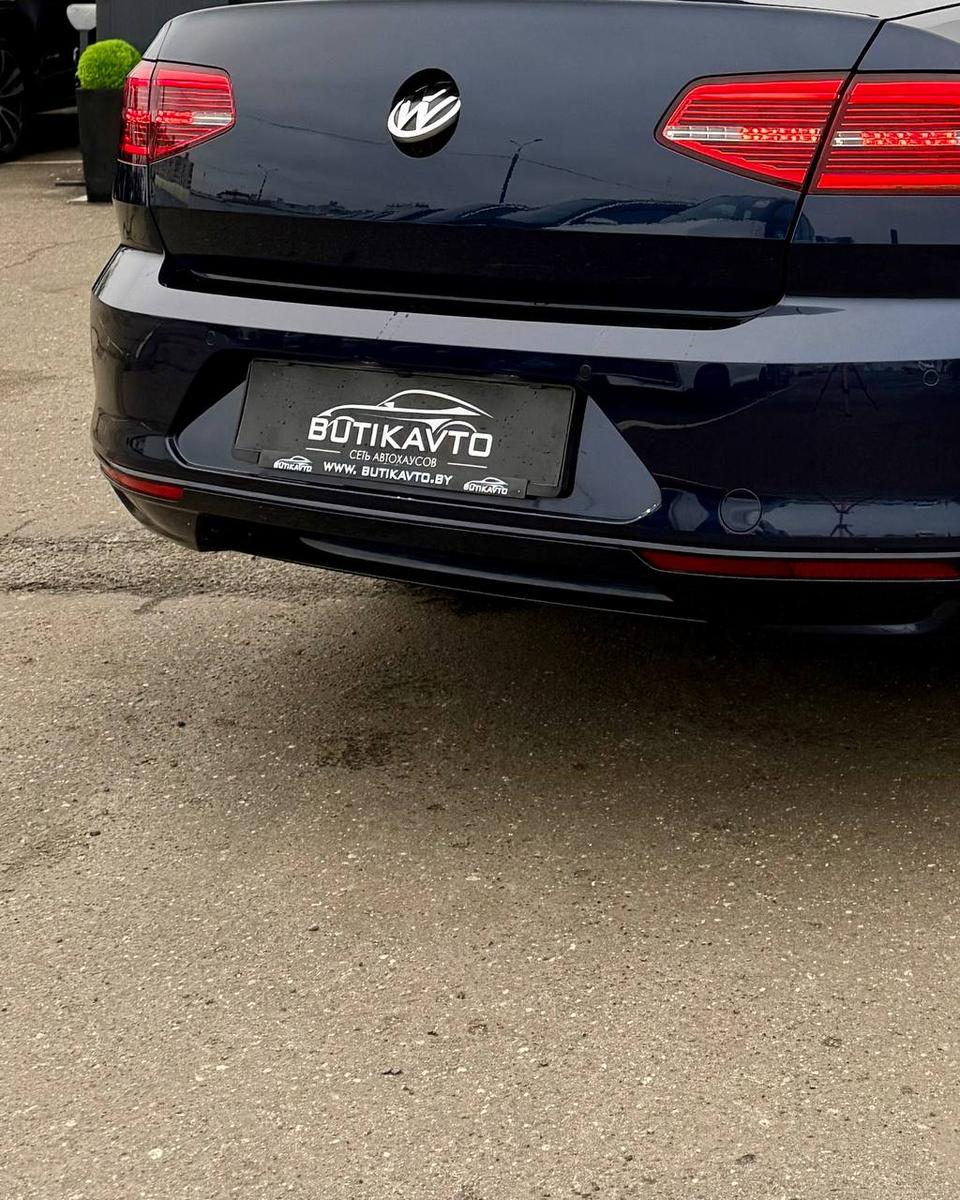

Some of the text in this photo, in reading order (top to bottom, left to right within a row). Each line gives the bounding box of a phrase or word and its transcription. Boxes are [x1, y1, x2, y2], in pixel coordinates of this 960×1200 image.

[307, 417, 493, 458] BUTIKAVTO
[349, 449, 437, 468] СЕТЬ АВТОХАУСОВ
[323, 461, 453, 486] WWW. BUTIKAVTO.BY
[463, 483, 508, 495] BUTIKAVTO
